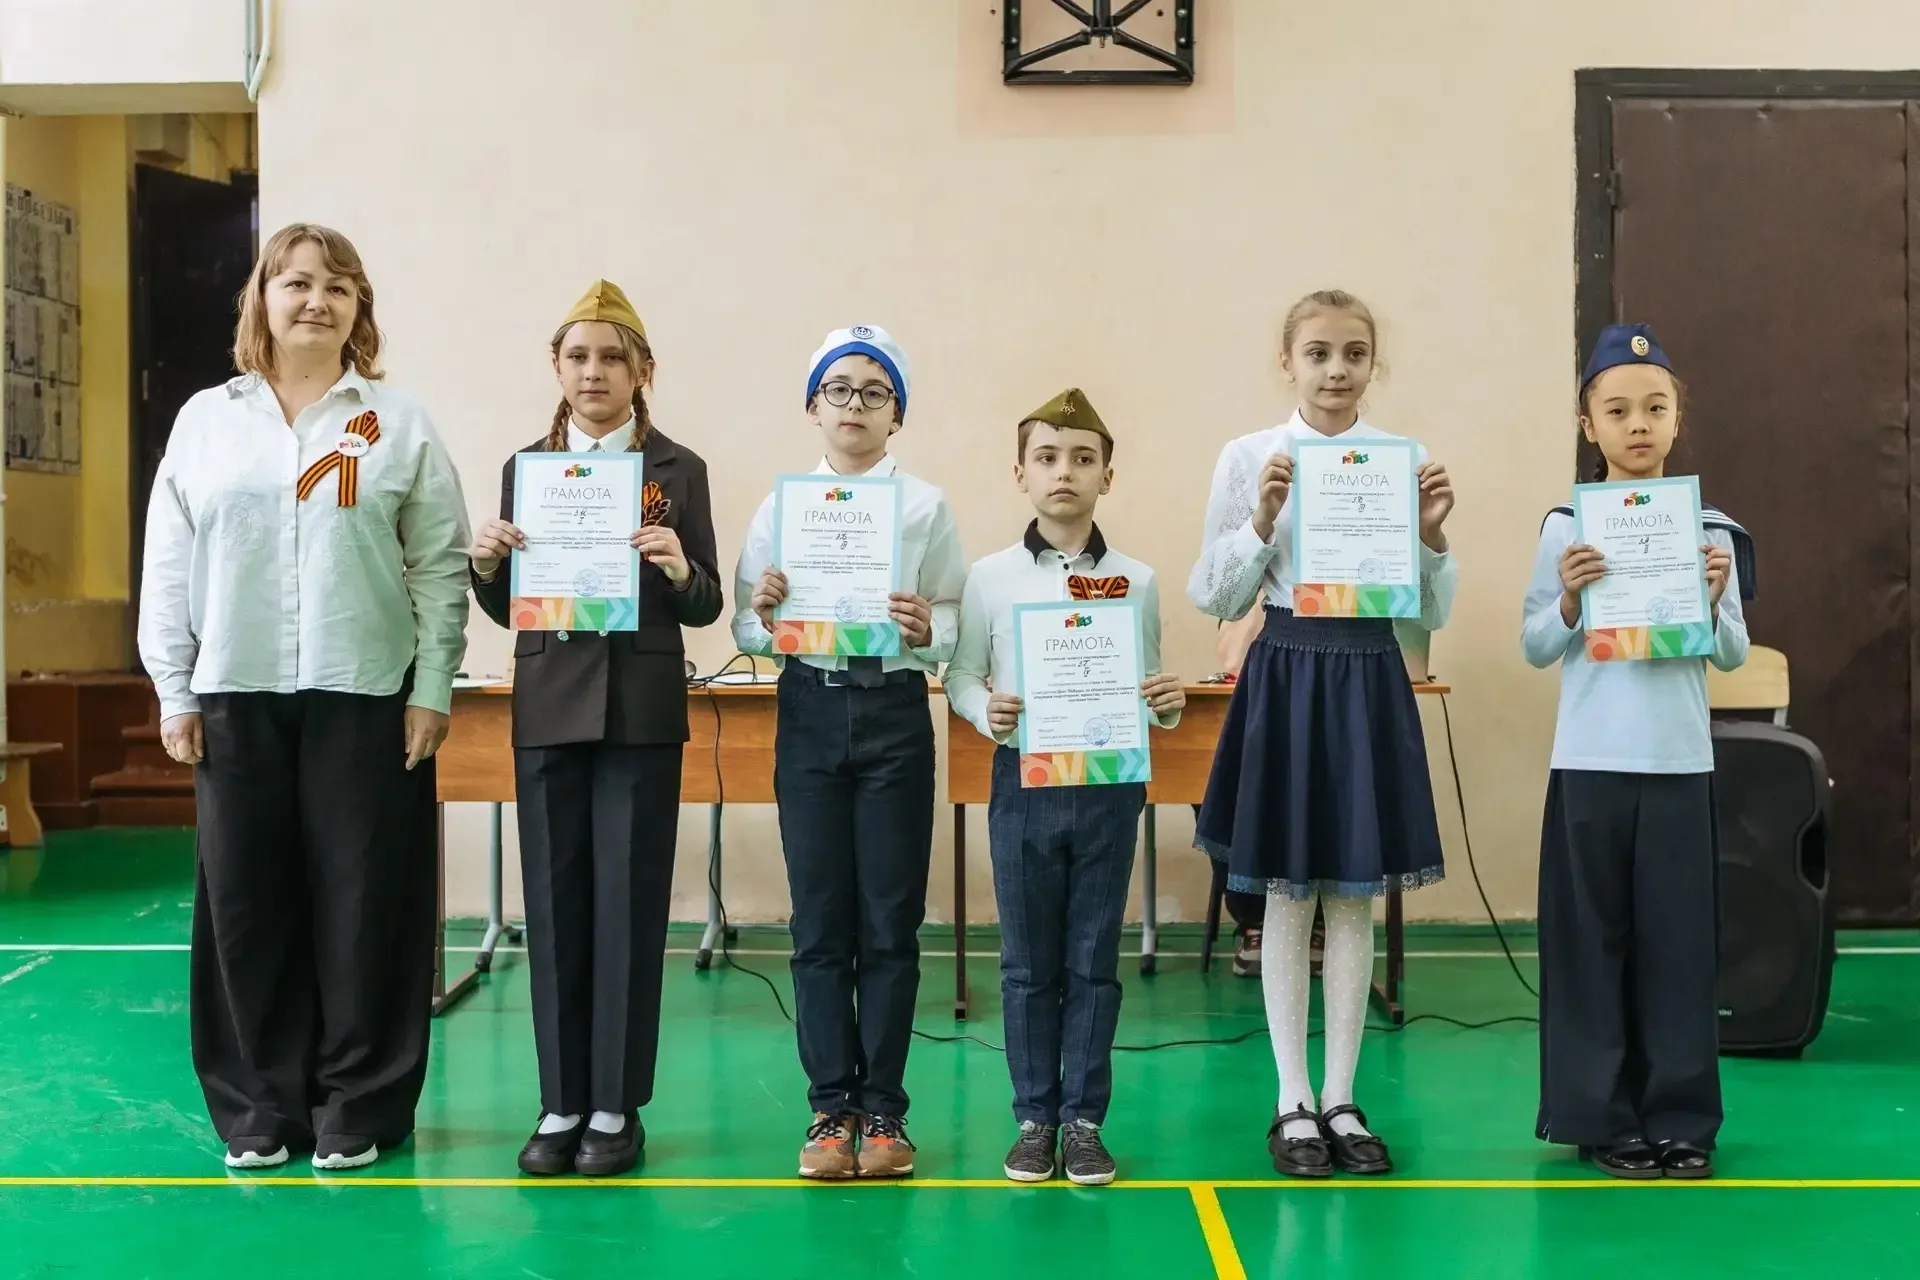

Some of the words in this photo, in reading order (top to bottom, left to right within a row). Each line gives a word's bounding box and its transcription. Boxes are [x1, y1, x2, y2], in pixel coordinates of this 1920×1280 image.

[1322, 473, 1390, 487] ГРАМОТА
[544, 487, 612, 500] ГРАМОТА
[804, 510, 873, 524] ГРАМОТА
[1605, 514, 1674, 530] ГРАМОТА
[1045, 636, 1115, 651] ГРАМОТА
